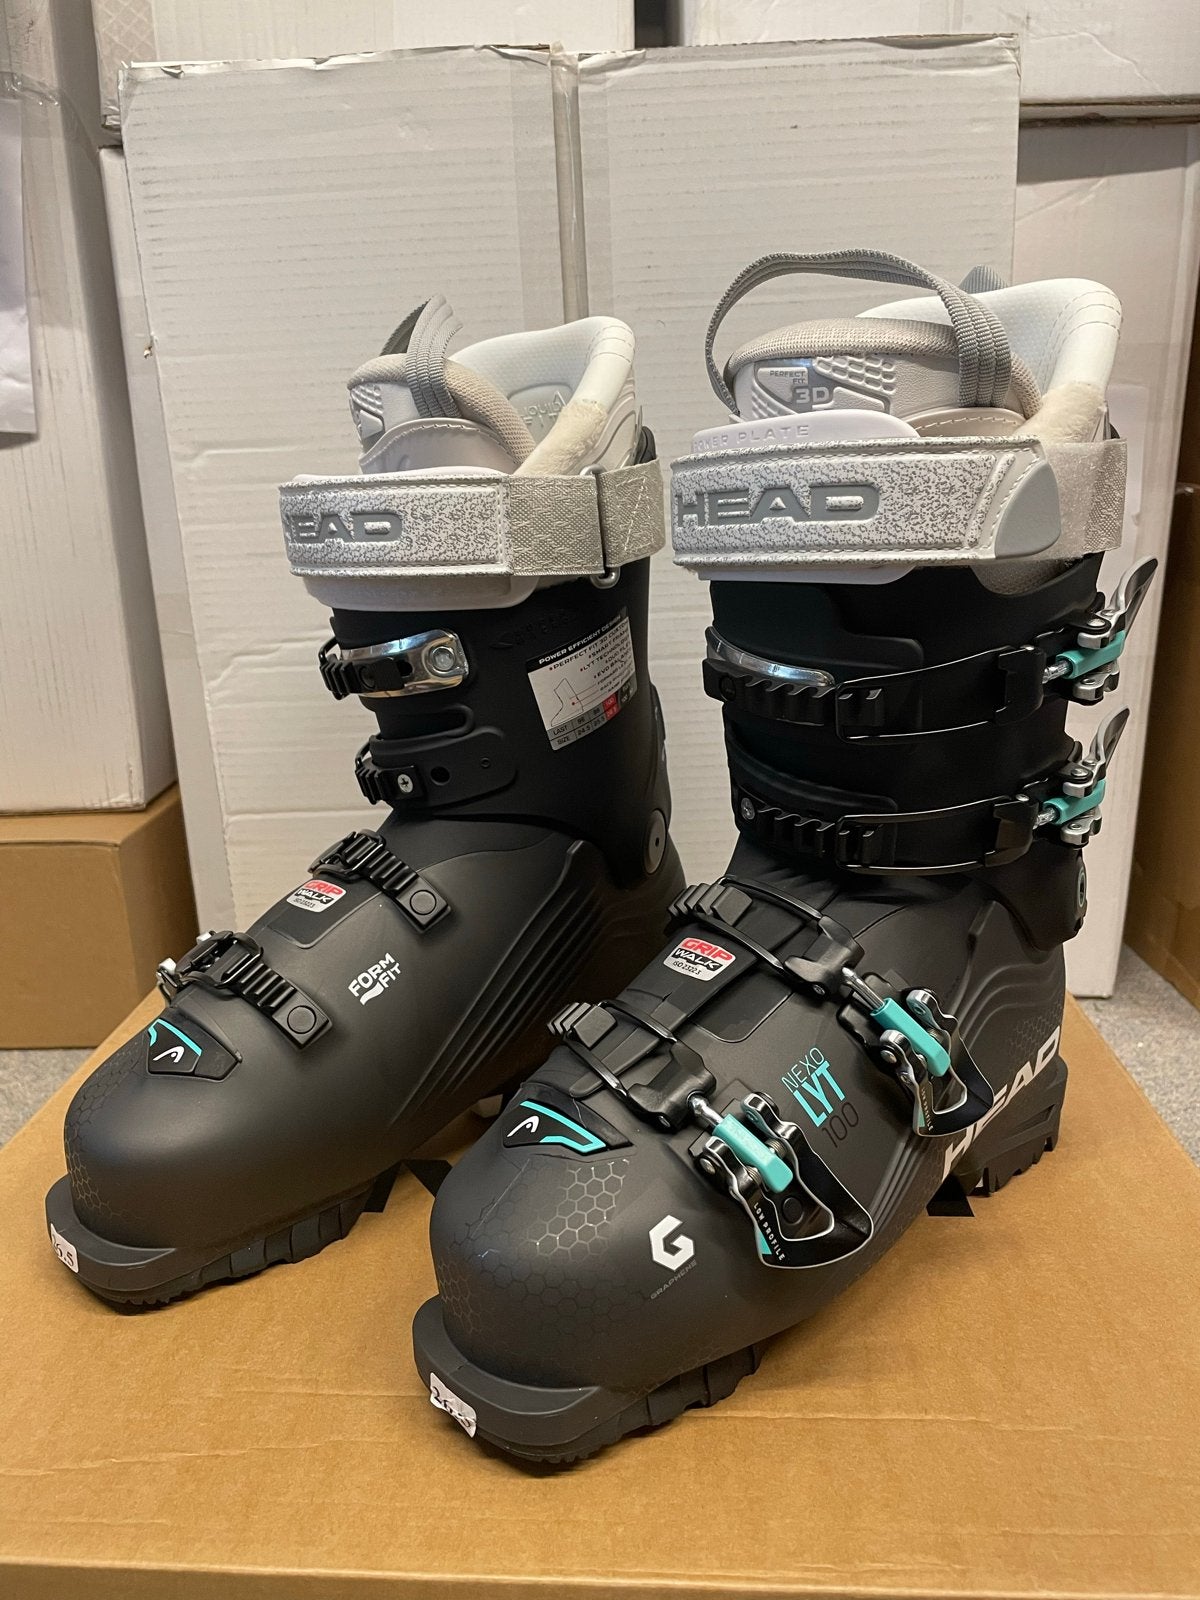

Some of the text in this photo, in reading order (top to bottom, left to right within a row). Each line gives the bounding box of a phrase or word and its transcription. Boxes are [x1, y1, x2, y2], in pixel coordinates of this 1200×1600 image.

[795, 386, 830, 404] 3D
[737, 425, 809, 444] PLATE
[676, 484, 880, 528] HEAD
[538, 648, 567, 664] POWER
[567, 629, 601, 652] EFFICIENT
[553, 648, 588, 669] PERFECT
[583, 660, 595, 670] LYT
[553, 724, 568, 736] LAST
[297, 889, 332, 903] WALK
[303, 881, 344, 896] GRIP
[674, 948, 720, 969] WALK
[682, 939, 733, 960] GRIP
[348, 952, 396, 997] FORM
[378, 962, 401, 988] FIT
[781, 1047, 825, 1093] NEXO
[793, 1060, 846, 1127] LYT
[942, 1025, 1060, 1182] HEAD
[821, 1102, 859, 1149] 100
[753, 1202, 786, 1261] LOW PROFILE
[650, 1258, 697, 1300] GRAPHENE
